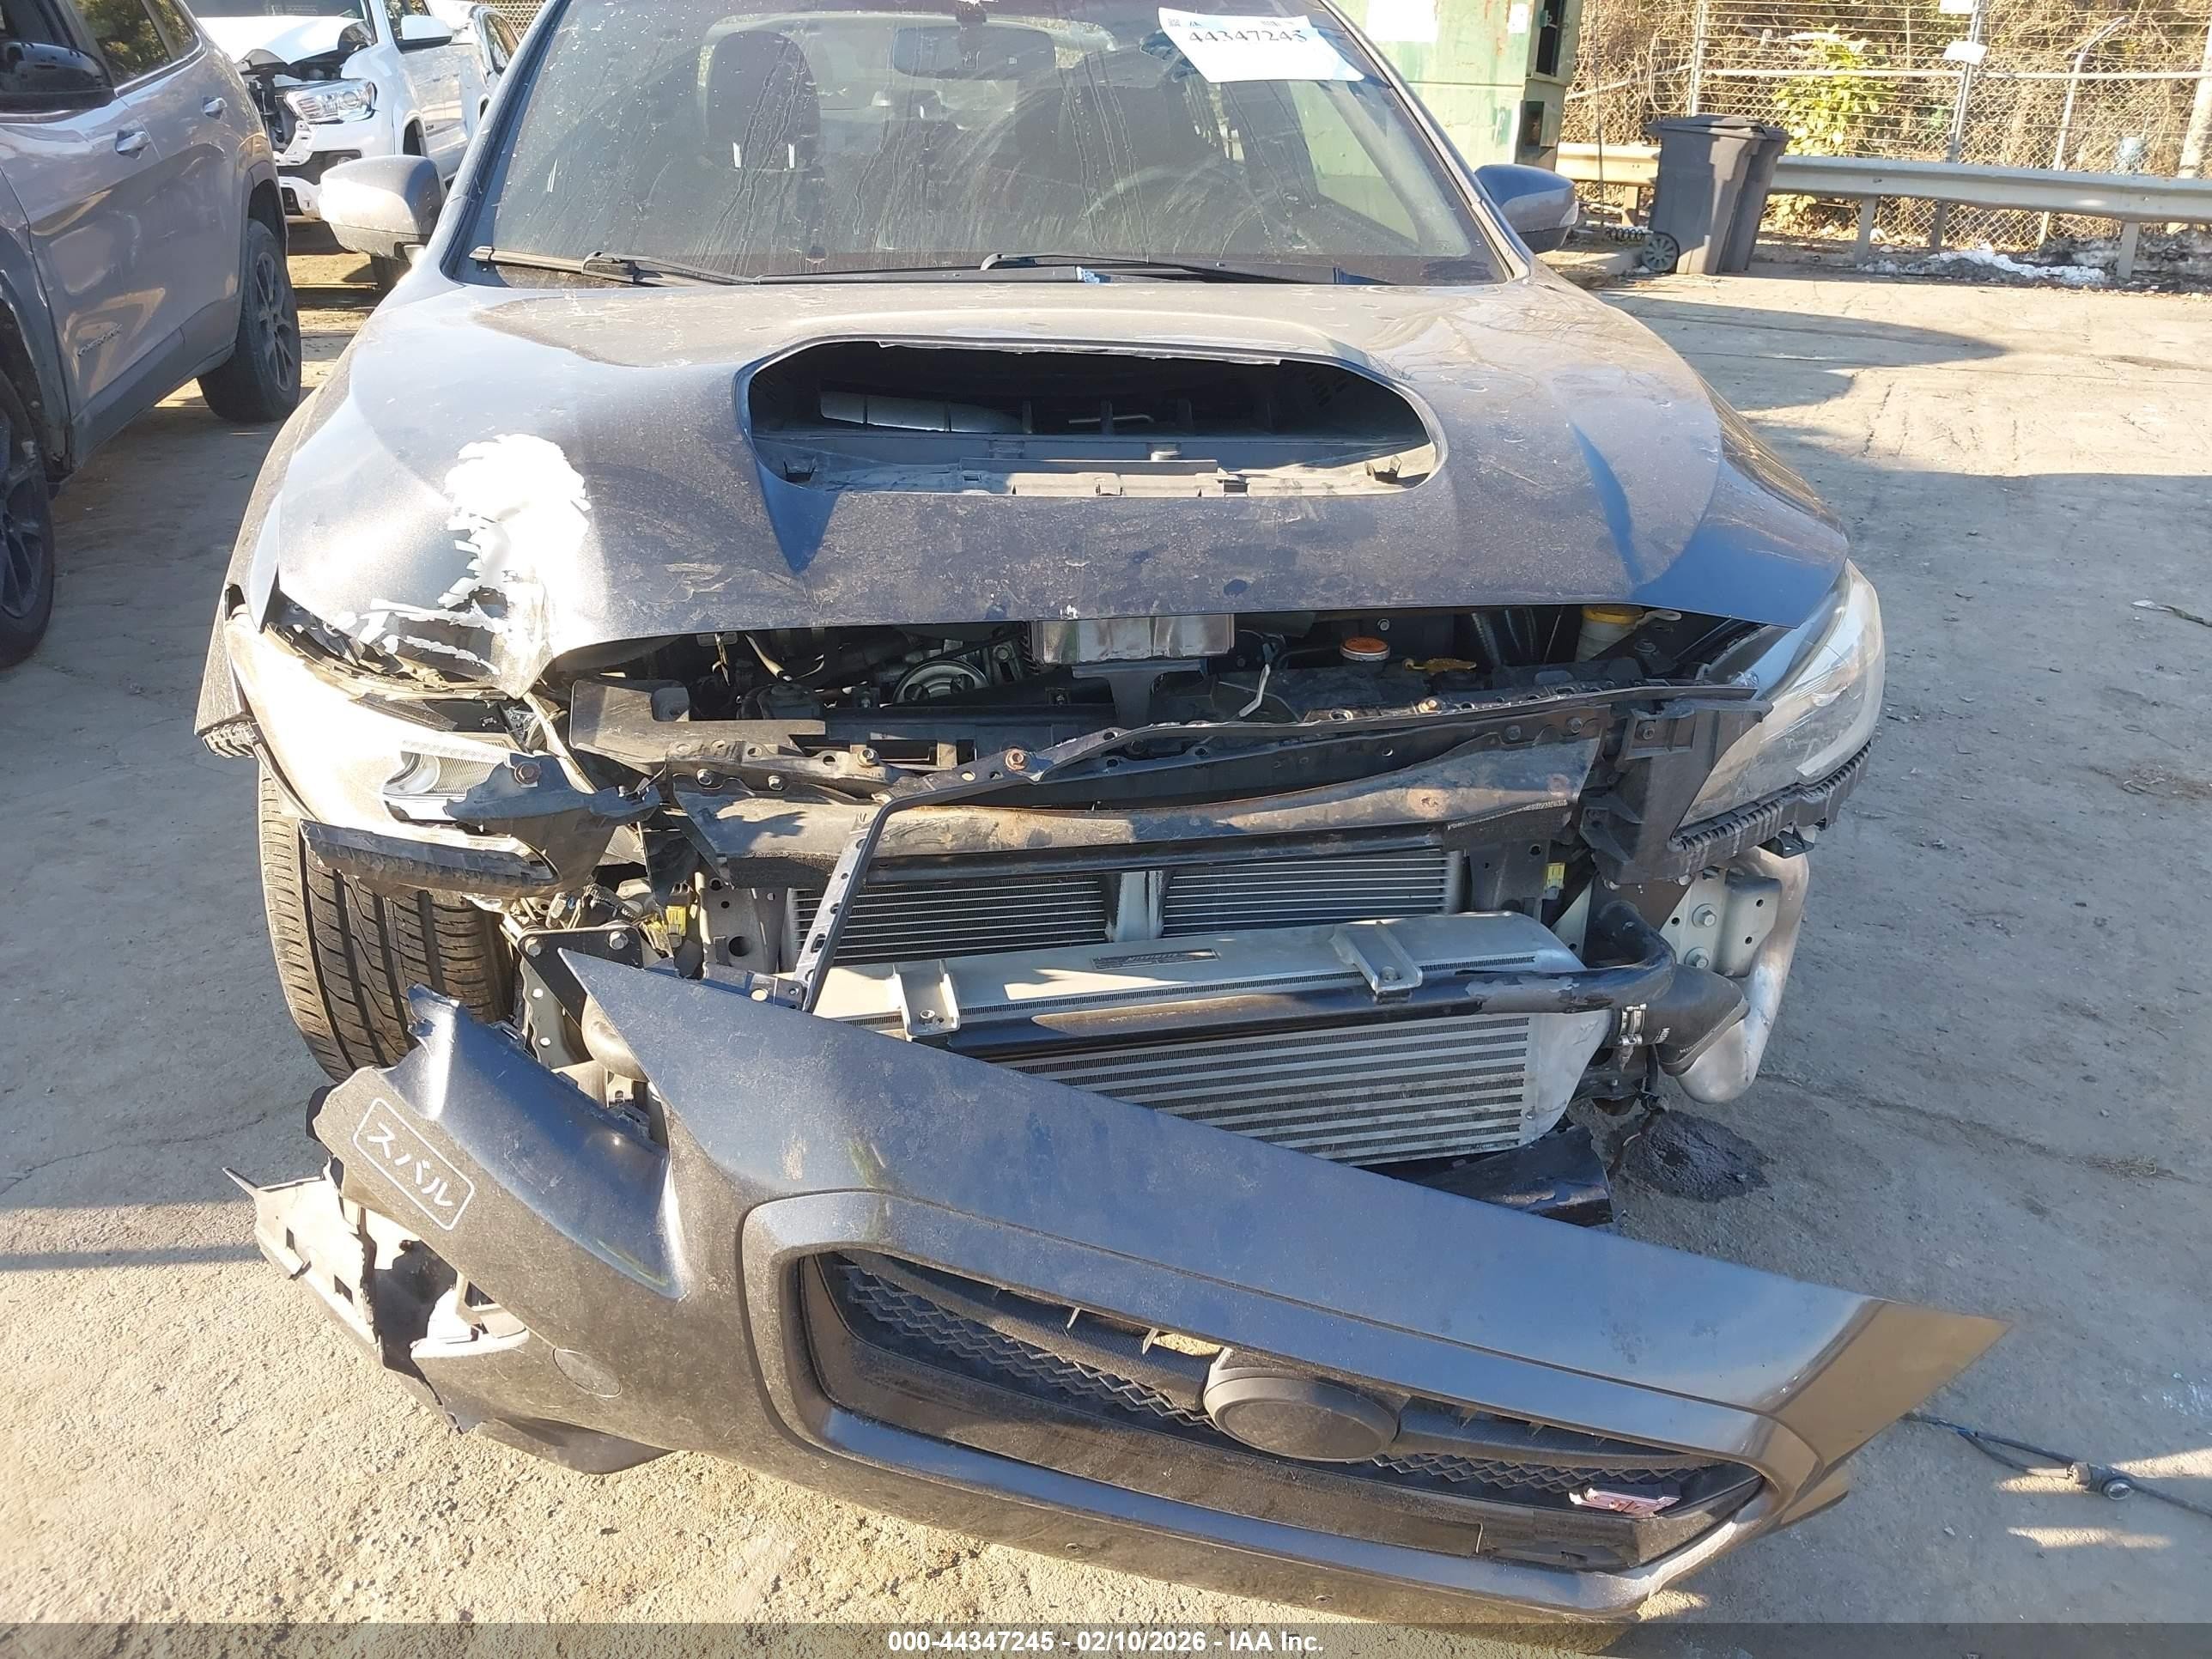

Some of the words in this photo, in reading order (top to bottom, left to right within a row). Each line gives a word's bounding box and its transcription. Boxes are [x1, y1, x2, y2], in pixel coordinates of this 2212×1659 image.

[1189, 29, 1308, 43] 44347245
[367, 1121, 453, 1206] スバル
